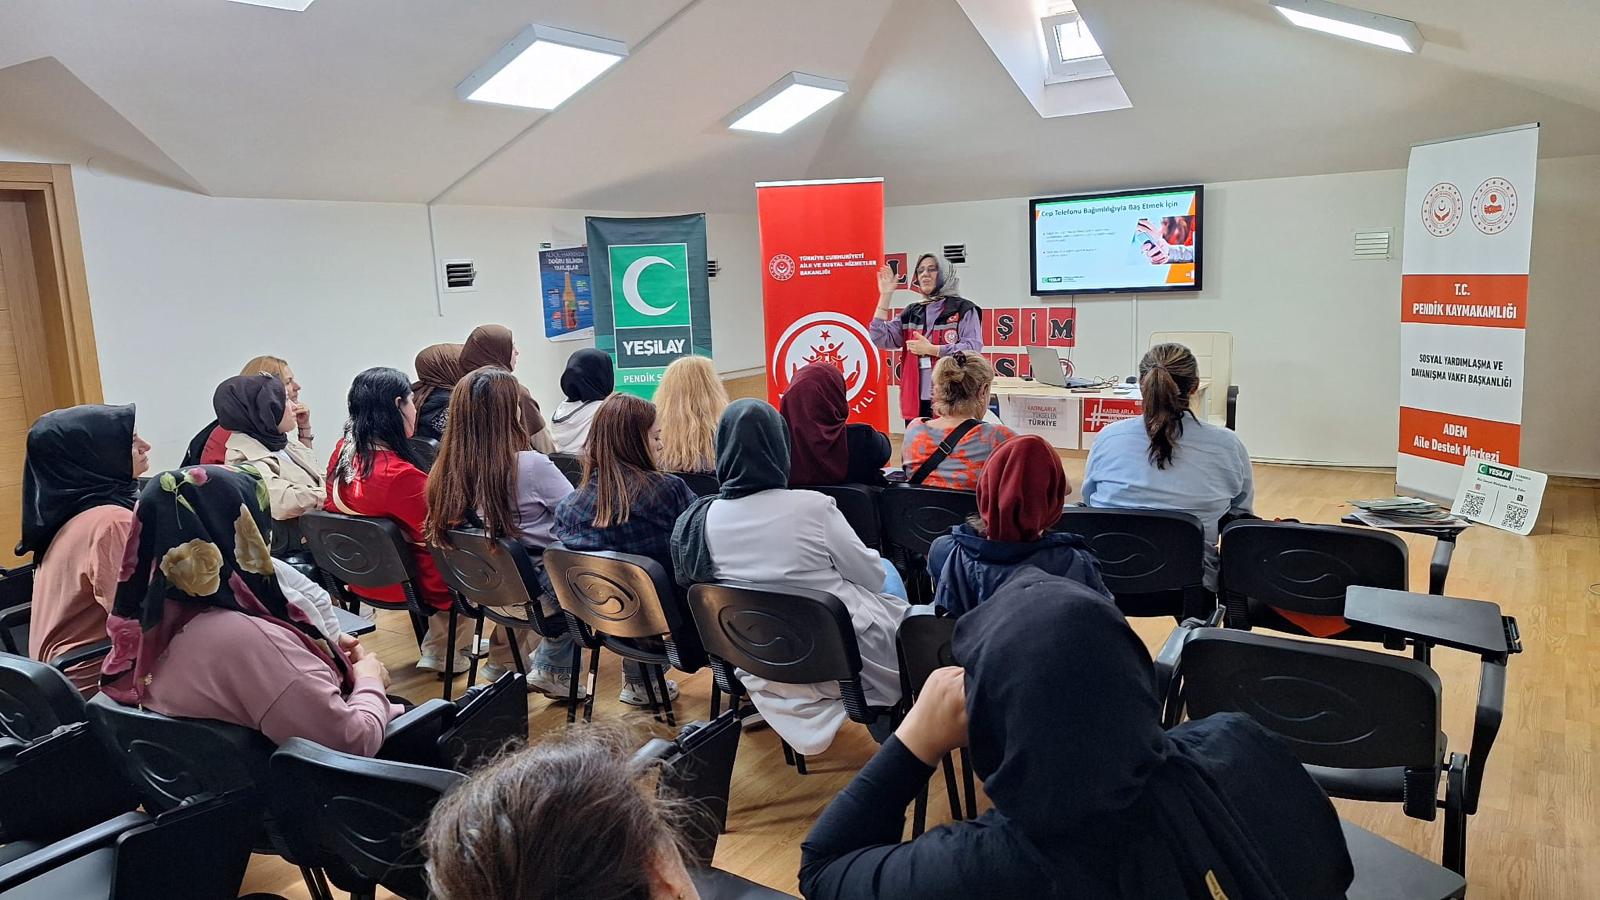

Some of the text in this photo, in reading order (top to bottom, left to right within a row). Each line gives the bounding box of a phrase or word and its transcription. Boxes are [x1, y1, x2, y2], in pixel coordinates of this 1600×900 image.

[1055, 208, 1082, 216] Telefonu
[1142, 202, 1164, 210] Etmek
[800, 268, 831, 276] BAKANLIĞI
[1454, 283, 1470, 296] T.C.
[1412, 300, 1517, 319] PENDİK KAYMAKAMLIĞI
[622, 339, 686, 356] YEŞİLAY
[1419, 354, 1503, 371] SOSYAL YARDIMLAŞMA VE
[623, 372, 655, 383] PENDİK
[1411, 368, 1512, 388] DAYANIŞMA VAKFI BAŞKANLIĞI
[852, 389, 877, 414] YILI
[1028, 418, 1057, 427] TÜRKİYE
[1443, 423, 1468, 438] ADEM
[1413, 435, 1500, 463] Aile Destek Merkezi
